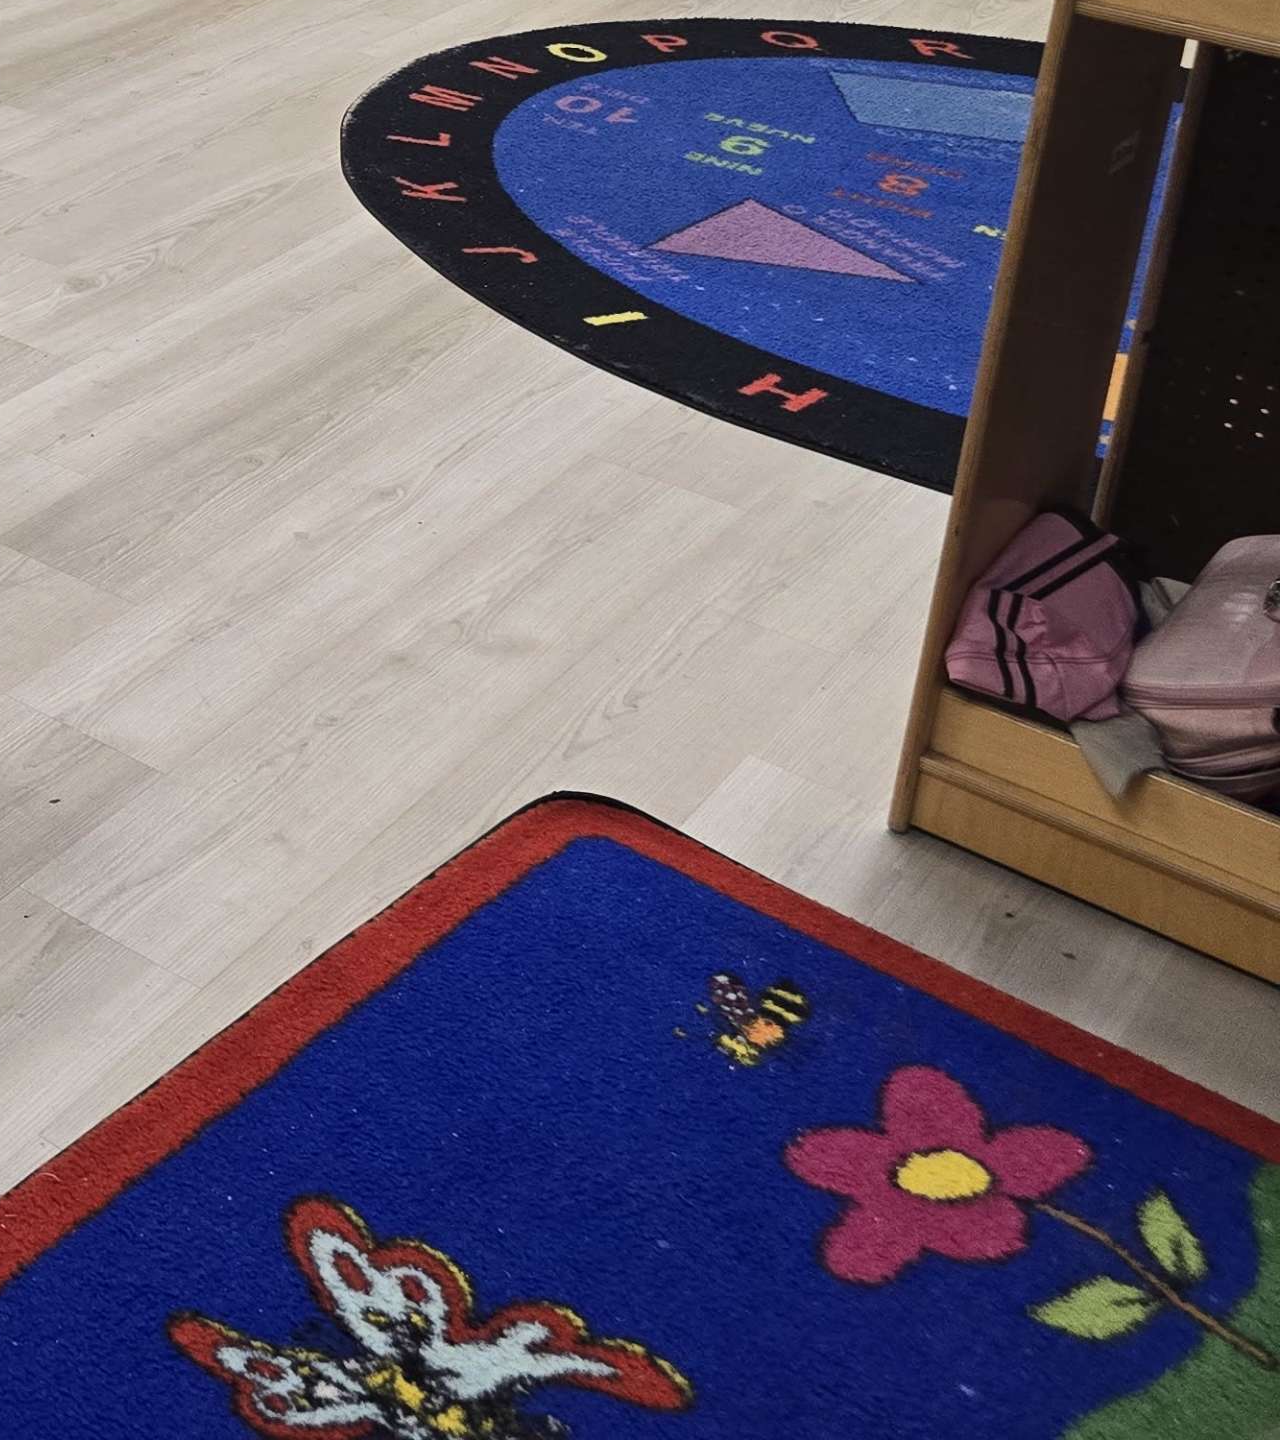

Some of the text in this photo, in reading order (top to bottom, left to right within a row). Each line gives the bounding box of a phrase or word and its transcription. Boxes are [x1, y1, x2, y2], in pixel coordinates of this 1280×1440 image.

[545, 43, 608, 63] O
[640, 34, 688, 52] P
[760, 30, 828, 53] Q
[909, 38, 975, 60] R
[469, 56, 540, 80] N
[408, 84, 483, 112] M
[386, 132, 451, 147] L
[391, 176, 467, 202] K
[738, 373, 830, 412] H
